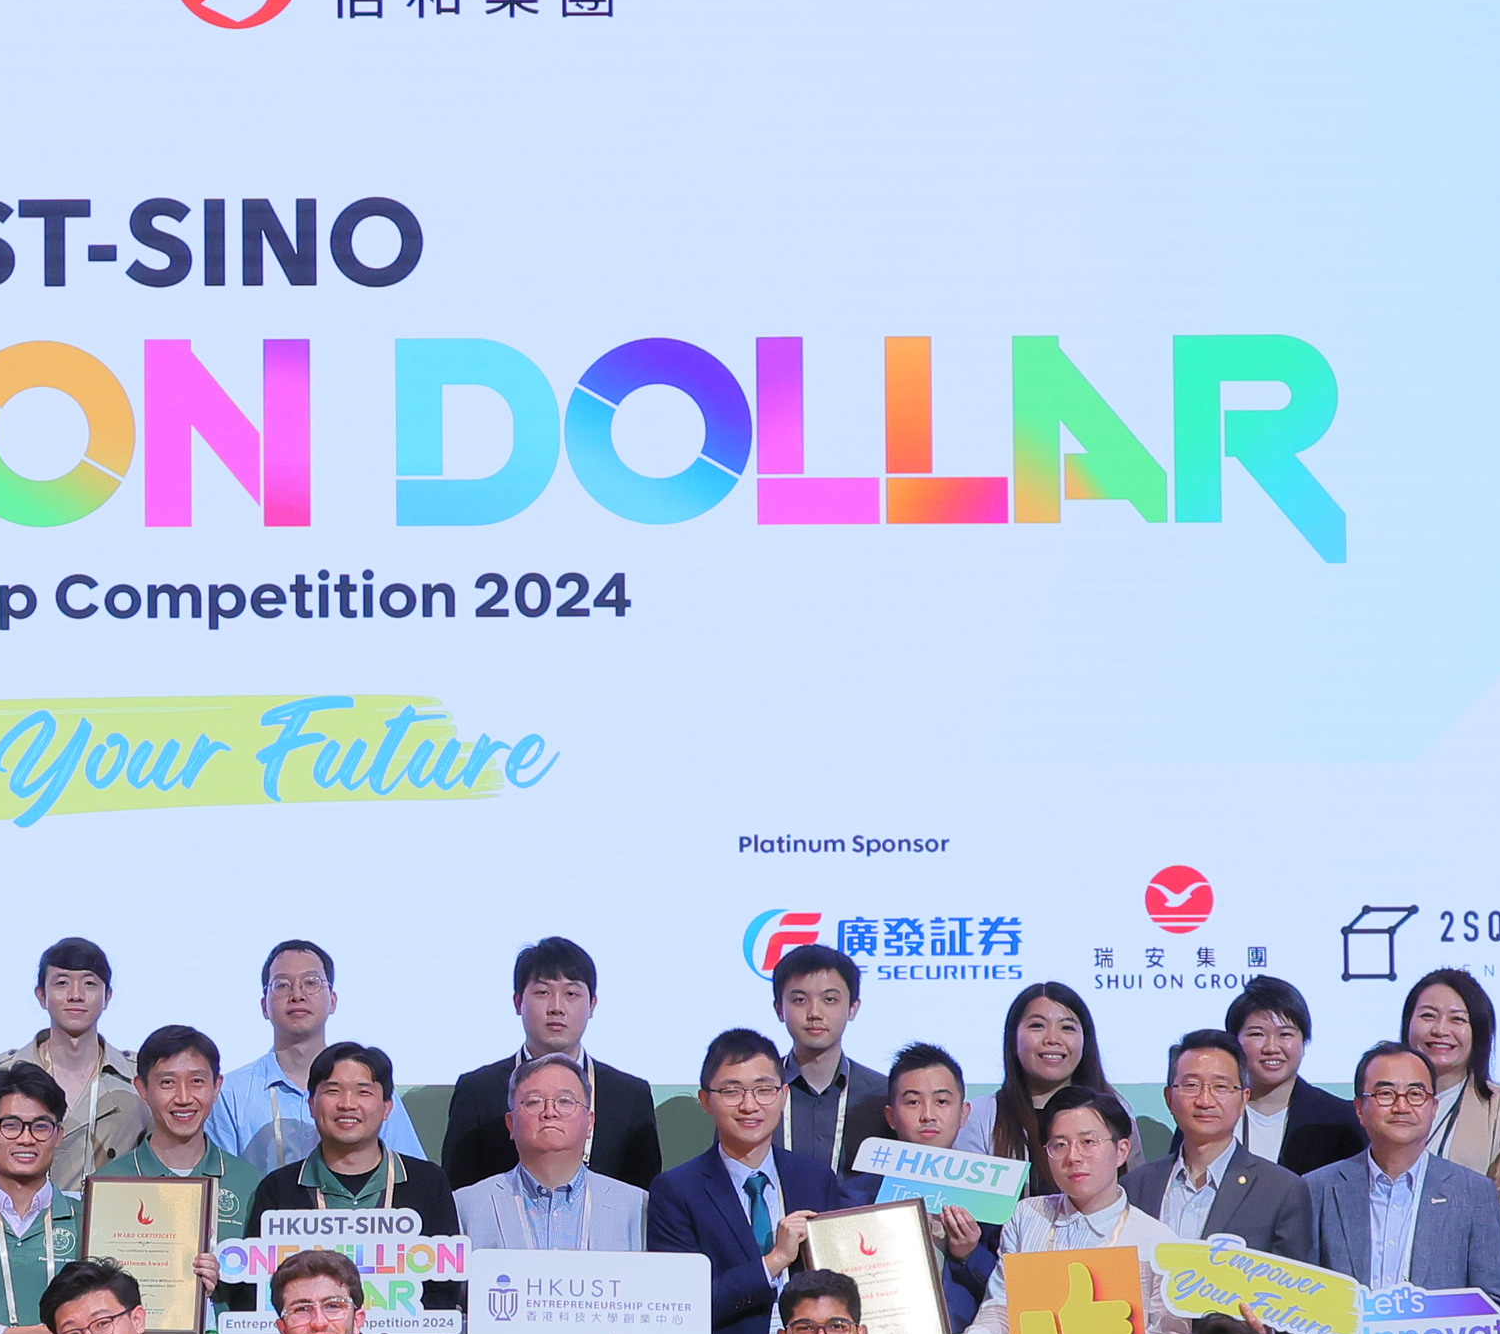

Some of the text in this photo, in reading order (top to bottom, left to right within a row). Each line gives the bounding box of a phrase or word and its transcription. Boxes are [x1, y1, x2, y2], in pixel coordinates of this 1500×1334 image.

[394, 334, 1347, 564] DOLLAR
[55, 568, 455, 632] Competition
[474, 571, 632, 619] 2024
[257, 694, 561, 803] Future
[738, 833, 950, 858] Platinum Sponsor
[837, 916, 1024, 957] 廣發証券
[1093, 946, 1268, 969] 瑞安集團
[877, 965, 1023, 981] SECURITIES
[1094, 974, 1143, 990] SHUI
[1152, 974, 1184, 990] ON
[268, 1216, 415, 1236] HKUST-SINO
[1208, 1237, 1327, 1296] Empower
[526, 1277, 622, 1297] HKUST
[1173, 1269, 1243, 1306] Your
[526, 1299, 692, 1312] ENTREPRENEURSHIP CENTER
[1361, 1287, 1426, 1316] Let's
[423, 1317, 455, 1328] 2024
[525, 1311, 685, 1326] 香港科技大學創業中心
